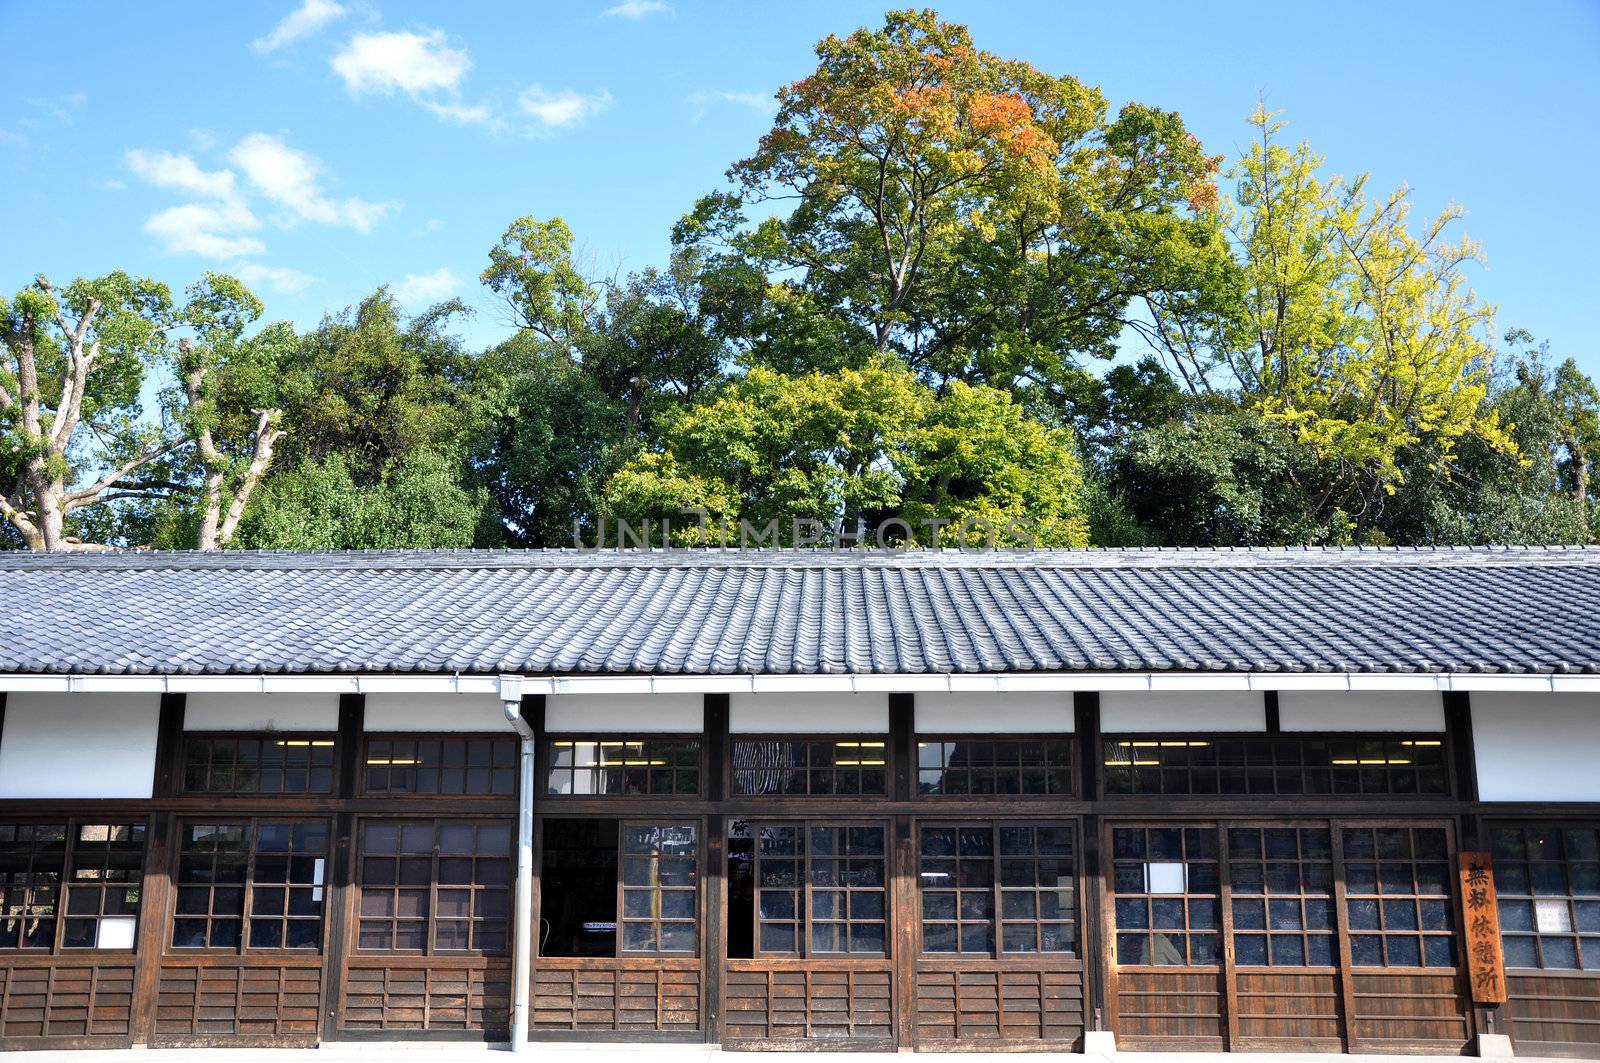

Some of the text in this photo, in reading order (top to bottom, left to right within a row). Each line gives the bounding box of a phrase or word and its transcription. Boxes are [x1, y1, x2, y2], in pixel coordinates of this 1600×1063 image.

[1465, 864, 1497, 990] 無料休憩所
